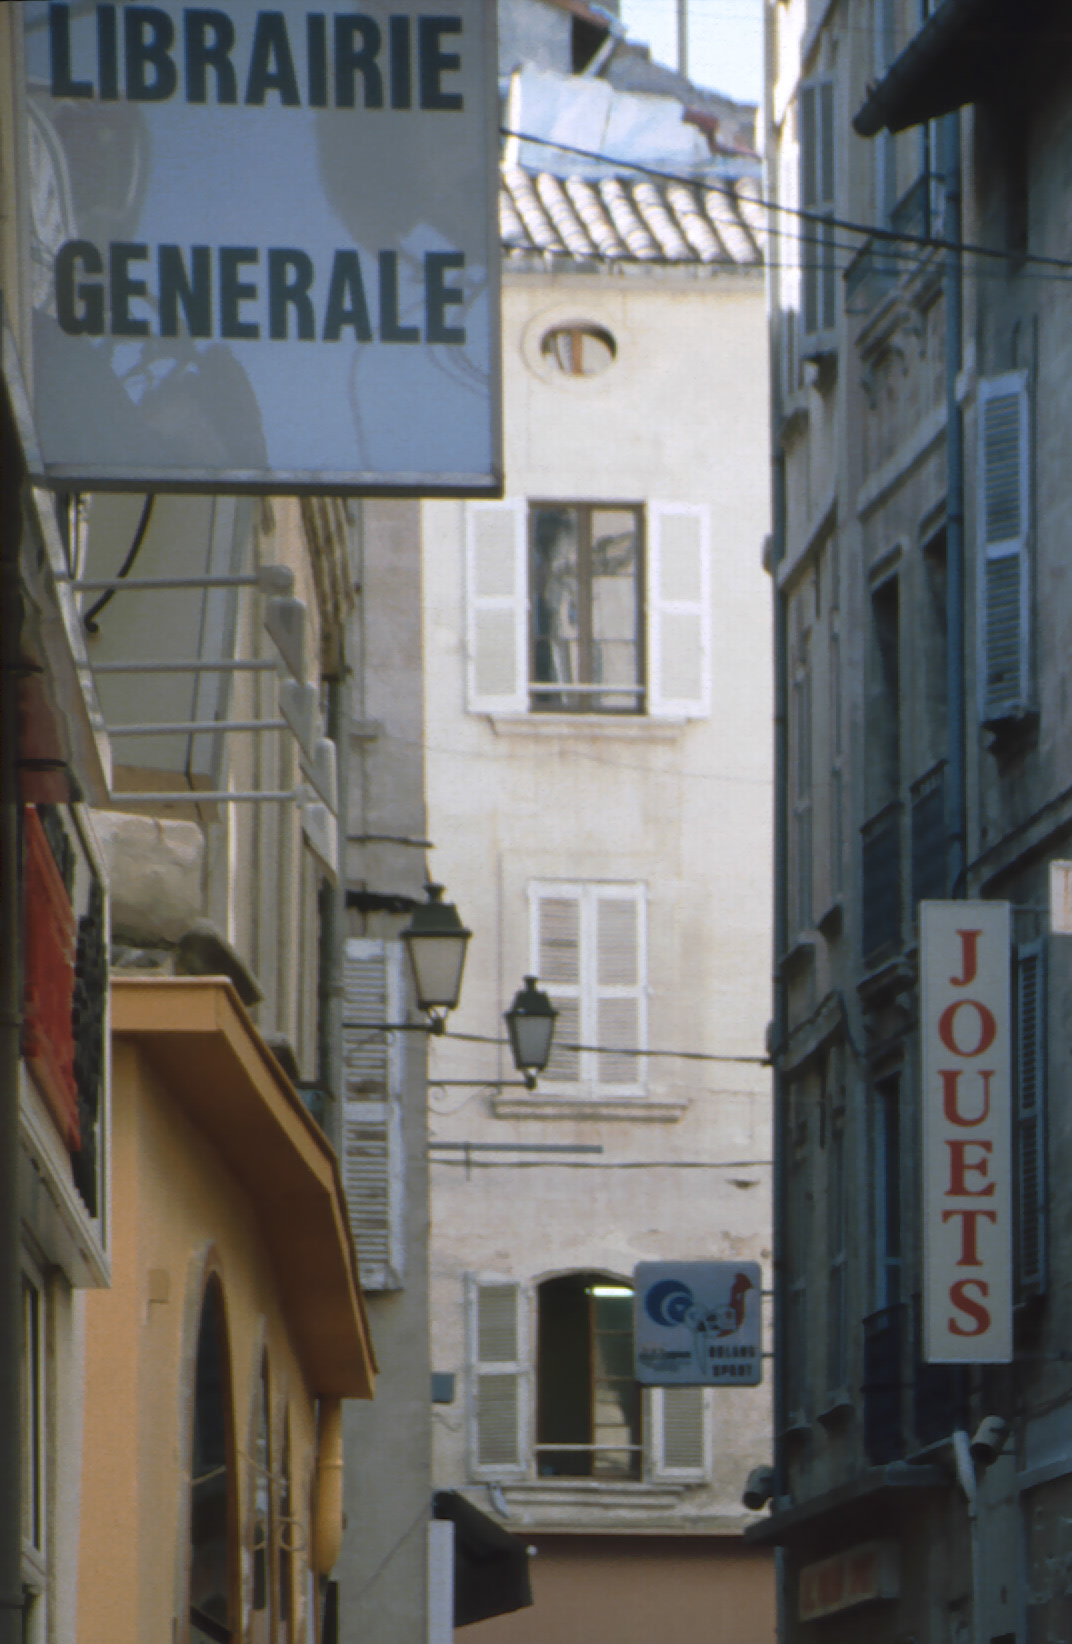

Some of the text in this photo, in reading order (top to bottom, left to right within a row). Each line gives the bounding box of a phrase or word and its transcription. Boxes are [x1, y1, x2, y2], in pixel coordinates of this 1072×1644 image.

[48, 2, 464, 111] LIBRAIRIE
[53, 239, 466, 344] GENERALE
[937, 929, 997, 1336] JOUETS
